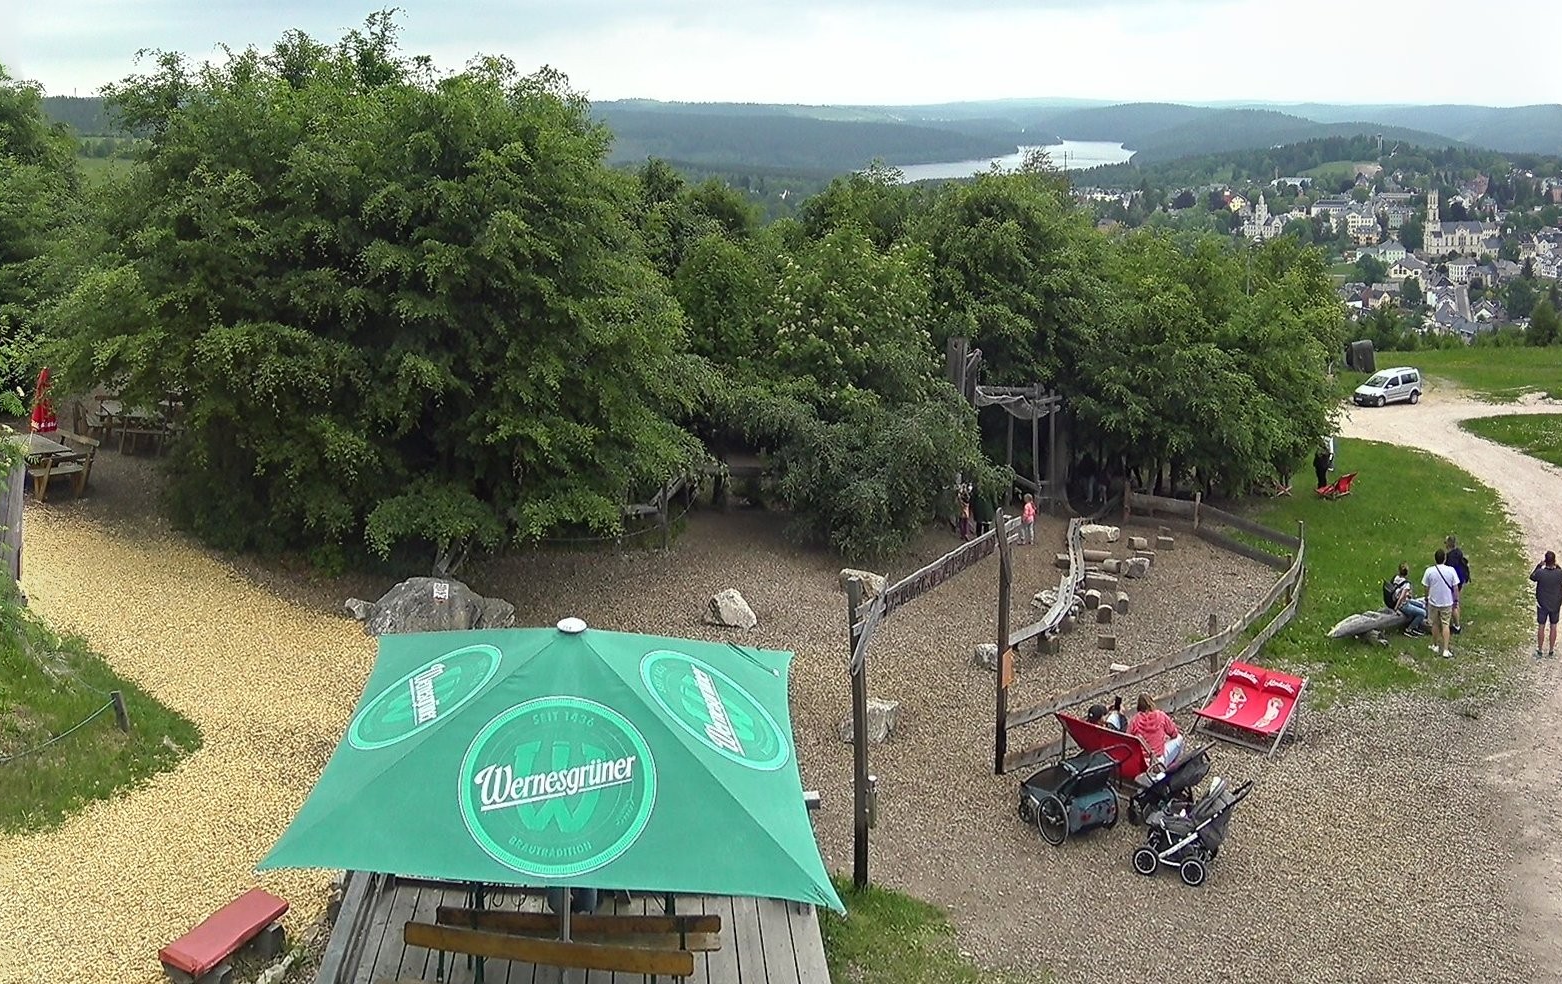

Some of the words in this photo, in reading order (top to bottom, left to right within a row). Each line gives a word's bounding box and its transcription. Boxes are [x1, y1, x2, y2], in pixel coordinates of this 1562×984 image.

[533, 711, 559, 725] SEIT
[564, 711, 595, 727] 1436
[474, 755, 637, 806] Wernesgrüner
[508, 835, 593, 858] BRAUTRADITION
